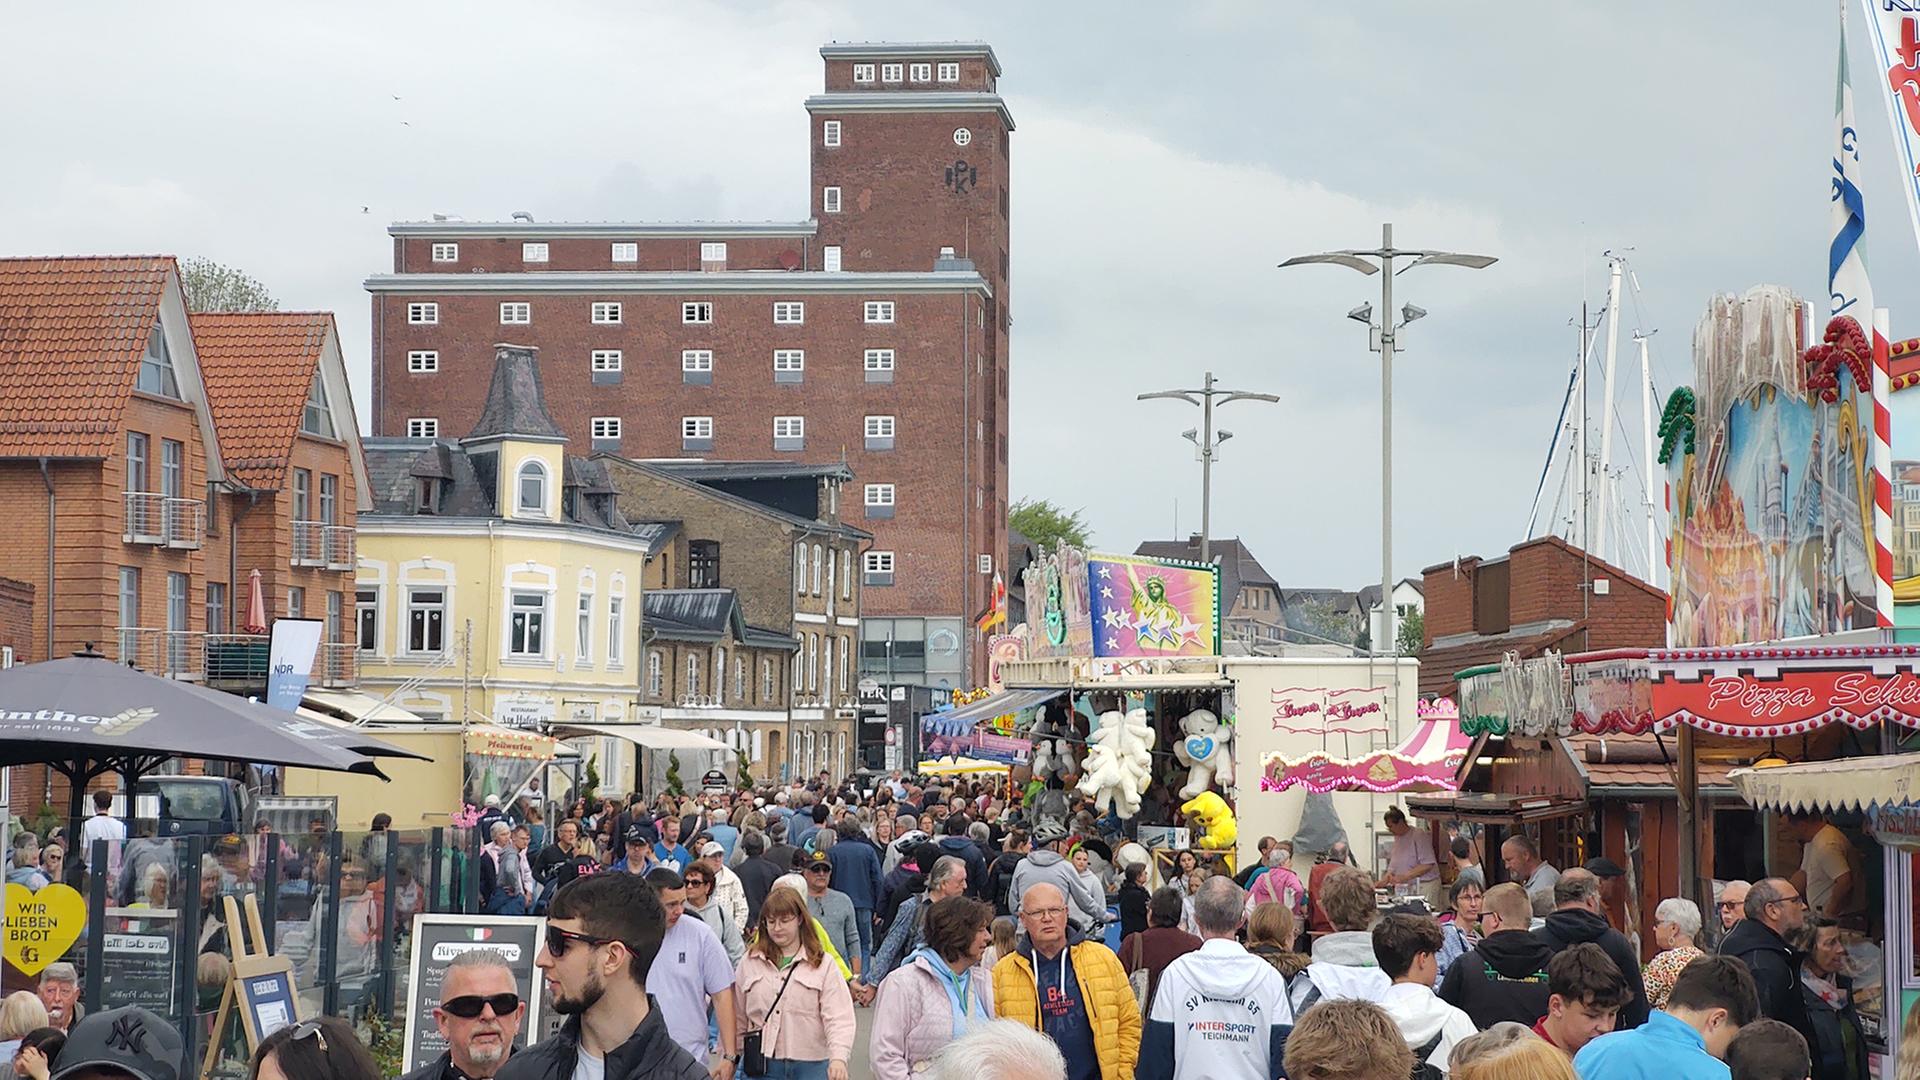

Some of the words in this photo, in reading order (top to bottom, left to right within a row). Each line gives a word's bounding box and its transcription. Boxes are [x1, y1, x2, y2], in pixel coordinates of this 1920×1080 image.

[273, 664, 294, 675] NDR
[1708, 676, 1815, 717] Pizza
[1829, 673, 1920, 706] Schi
[18, 903, 47, 914] WIR
[6, 916, 58, 928] LIEBEN
[10, 929, 51, 942] BROT
[1185, 995, 1199, 1012] SV
[1247, 1000, 1261, 1015] 65
[1195, 1022, 1256, 1034] INTERSPORT
[1202, 1032, 1250, 1042] TEICHMANN
